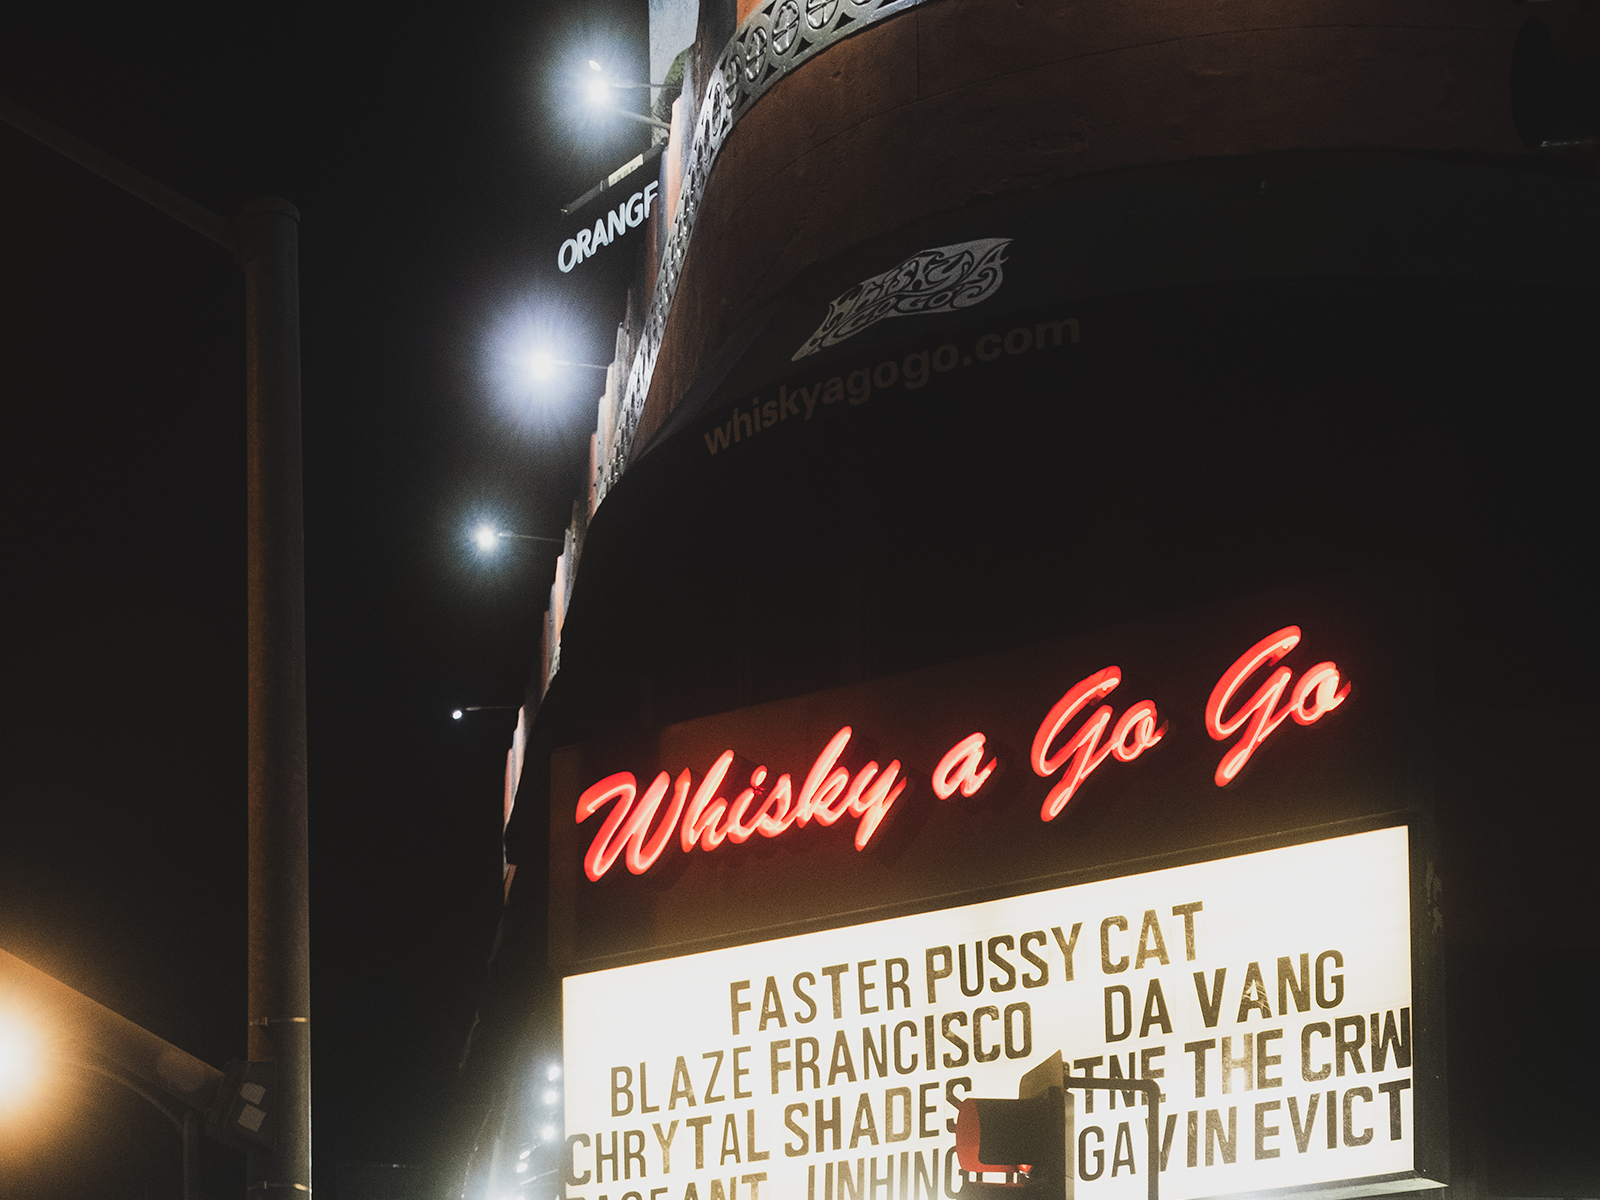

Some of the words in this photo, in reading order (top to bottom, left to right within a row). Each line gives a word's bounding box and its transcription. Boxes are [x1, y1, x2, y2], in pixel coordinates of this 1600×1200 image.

[703, 317, 1081, 456] whiskyagogo.com
[575, 726, 906, 883] Whisky
[931, 732, 998, 800] a
[1030, 665, 1167, 822] Go
[1204, 625, 1351, 787] Go
[611, 1046, 753, 1117] BLAZE
[770, 1001, 1032, 1095] FRANCISCO
[1104, 978, 1173, 1044] DA
[1193, 950, 1345, 1028] VANG
[729, 957, 912, 1036] FASTER
[925, 922, 1083, 1004] PUSSY
[1100, 901, 1203, 975] CAT
[564, 1108, 770, 1187] CHRYTAL
[784, 1076, 972, 1158] SHADES
[1184, 1028, 1284, 1099] THE
[1301, 1007, 1412, 1083] CRW
[1078, 1106, 1237, 1182] GAVIN
[1255, 1079, 1412, 1161] EVICT
